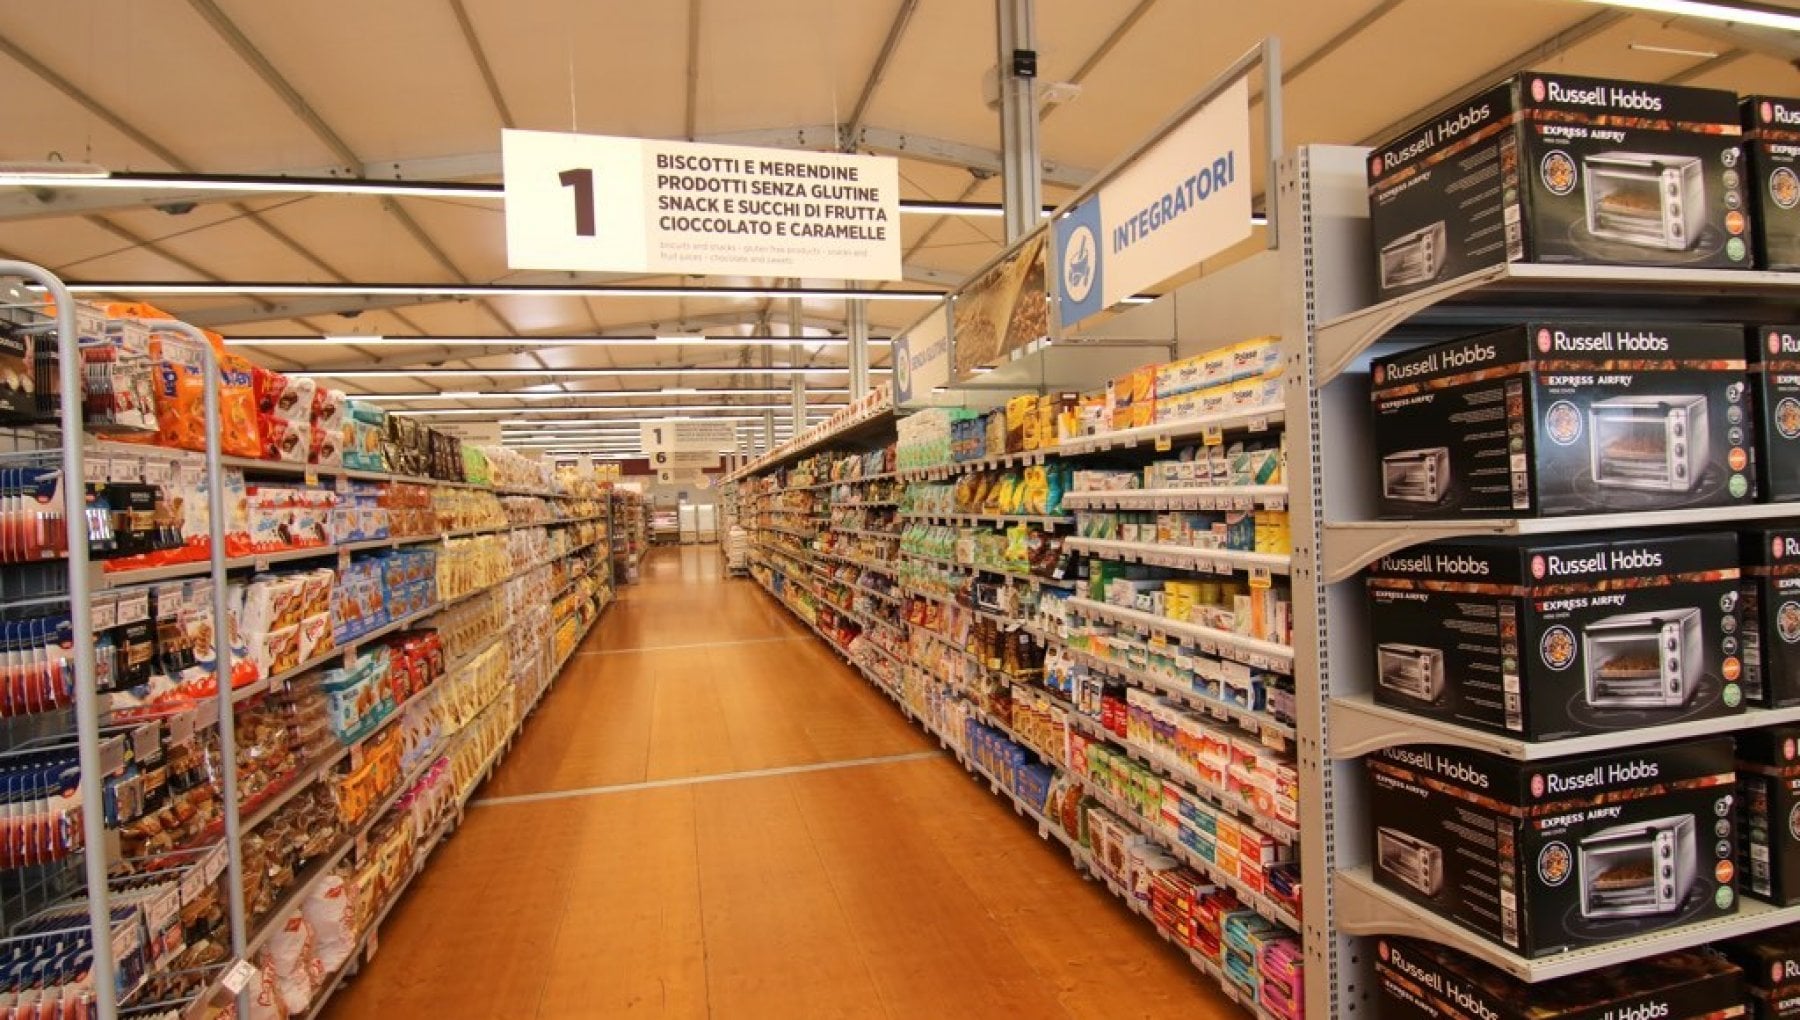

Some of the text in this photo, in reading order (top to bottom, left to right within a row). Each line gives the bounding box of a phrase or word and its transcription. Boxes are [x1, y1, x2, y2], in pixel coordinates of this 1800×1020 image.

[1548, 82, 1662, 112] Russell Hobbs
[1384, 129, 1435, 171] Russell
[1438, 104, 1490, 142] Hobbs
[656, 154, 858, 182] BISCOTTI E MERENDINE
[559, 168, 596, 236] 1
[657, 174, 880, 202] PRODOTTI SENZA GLUTINE
[1113, 150, 1234, 254] INTEGRATORI
[658, 194, 888, 222] SNACK E SUCCHI DI FRUTTA
[660, 216, 886, 241] CIOCCOLATO E CARAMELLE
[1554, 331, 1669, 350] Russell Hobbs
[1386, 344, 1496, 380] Russell Hobbs
[1548, 375, 1632, 388] EXPRESS AIRFRY
[654, 428, 662, 445] 1
[1382, 554, 1490, 576] Russell Hobbs
[1548, 548, 1662, 576] Russell Hobbs
[1542, 594, 1626, 611] EXPRESS AIRFRY
[1437, 756, 1490, 788] Hobbs
[1548, 760, 1659, 794] Russell Hobbs
[1541, 812, 1584, 828] EXPRESS
[1392, 948, 1442, 993] Russell
